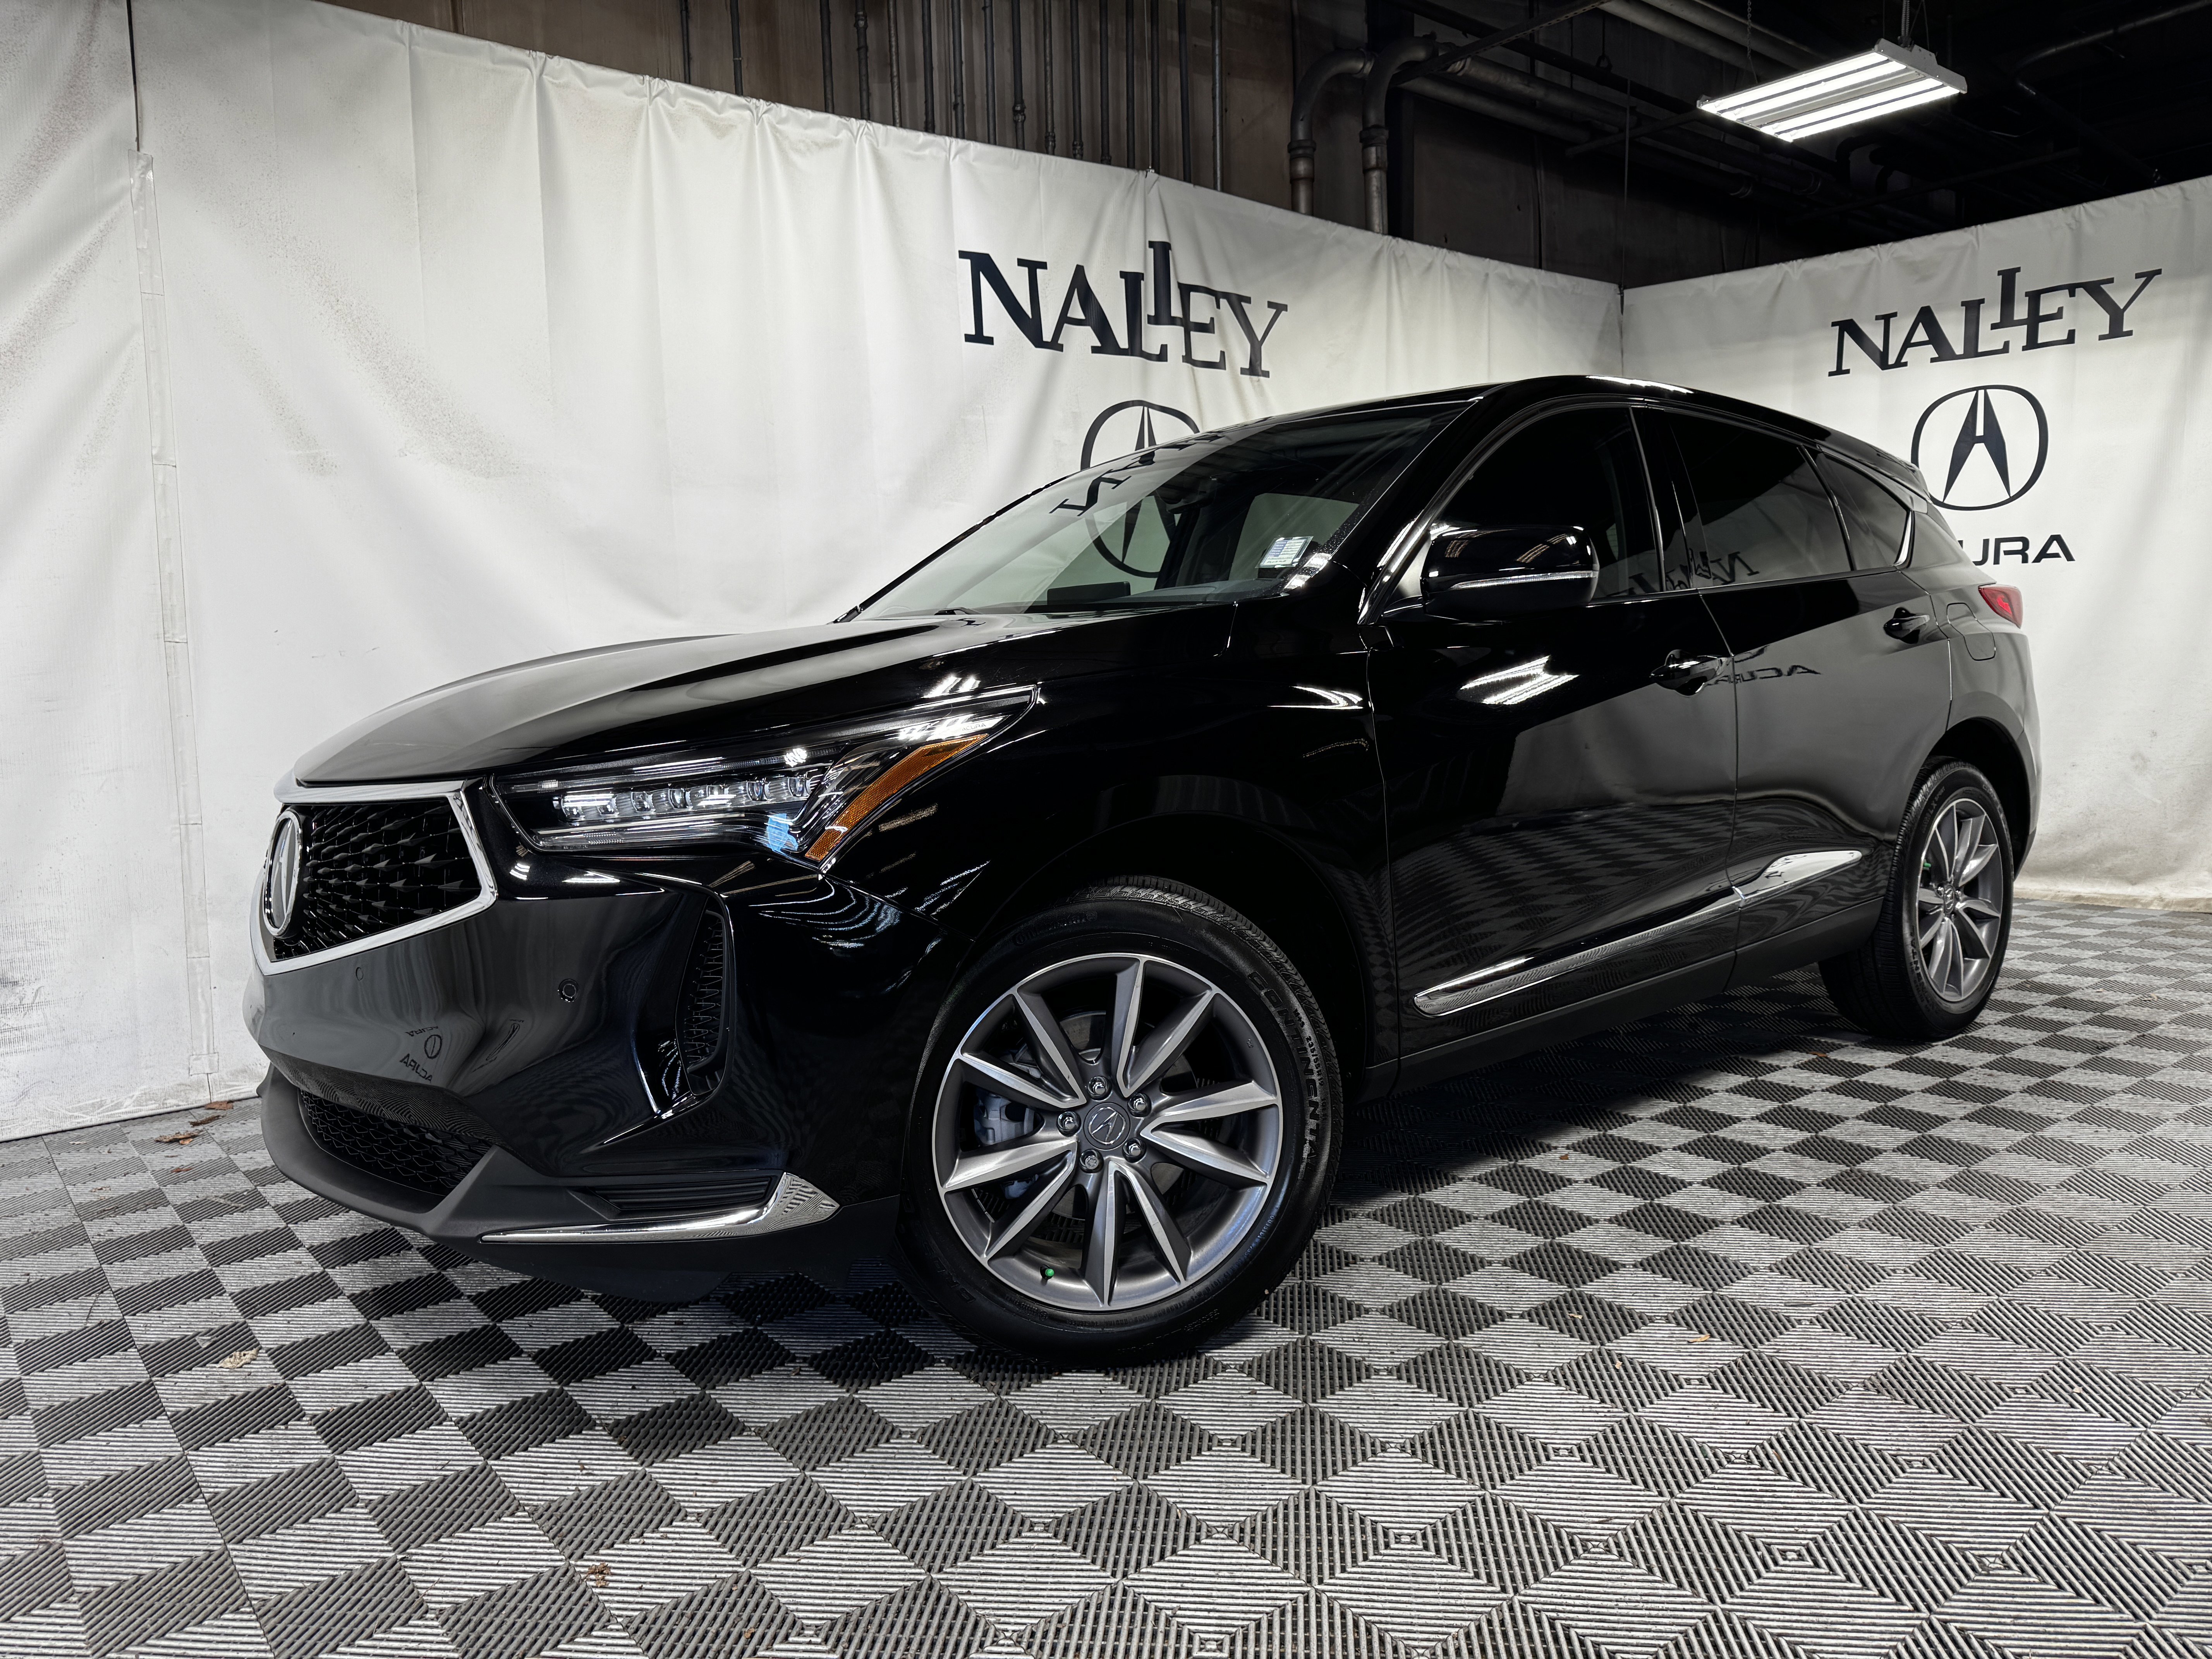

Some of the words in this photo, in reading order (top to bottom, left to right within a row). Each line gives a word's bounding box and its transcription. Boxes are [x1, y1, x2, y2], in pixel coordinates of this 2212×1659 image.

[958, 240, 1288, 378] NALLEY
[1828, 266, 2162, 377] NALLEY
[1958, 534, 2076, 566] URA
[1293, 1008, 1304, 1028] M+S
[1248, 971, 1320, 1180] CONTINENTAL
